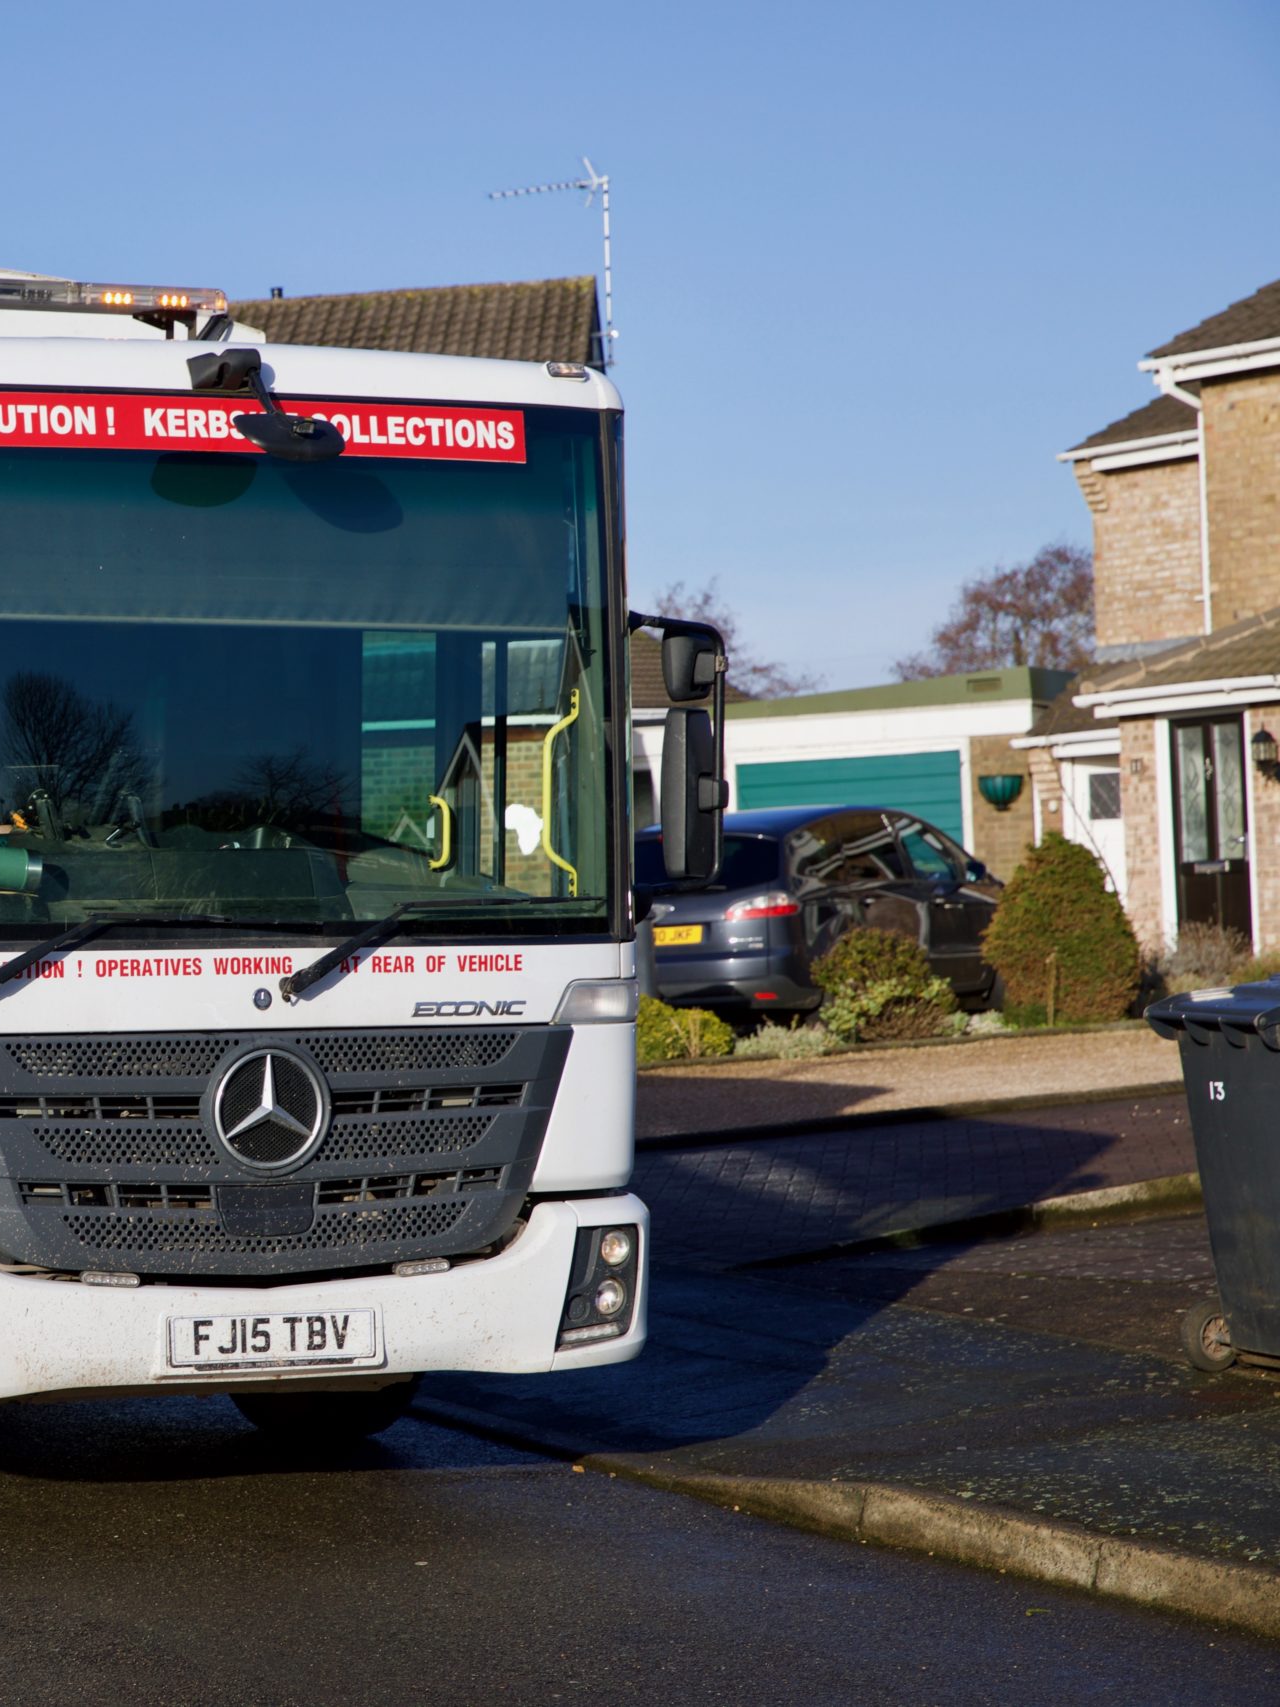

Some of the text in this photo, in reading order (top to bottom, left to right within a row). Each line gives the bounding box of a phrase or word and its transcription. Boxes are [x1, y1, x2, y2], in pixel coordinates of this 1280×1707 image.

[105, 406, 116, 435] !
[143, 408, 298, 440] KERB
[312, 413, 516, 450] OLLECTIONS
[95, 957, 202, 977] OPERATIVES
[214, 956, 293, 975] WORKING
[339, 955, 361, 973] AT
[372, 955, 415, 973] REAR
[426, 955, 446, 973] OF
[457, 954, 523, 972] VEHICLE
[411, 1000, 526, 1018] ECONIC
[1209, 1080, 1226, 1101] 13
[193, 1315, 350, 1356] FJ15 TBV
